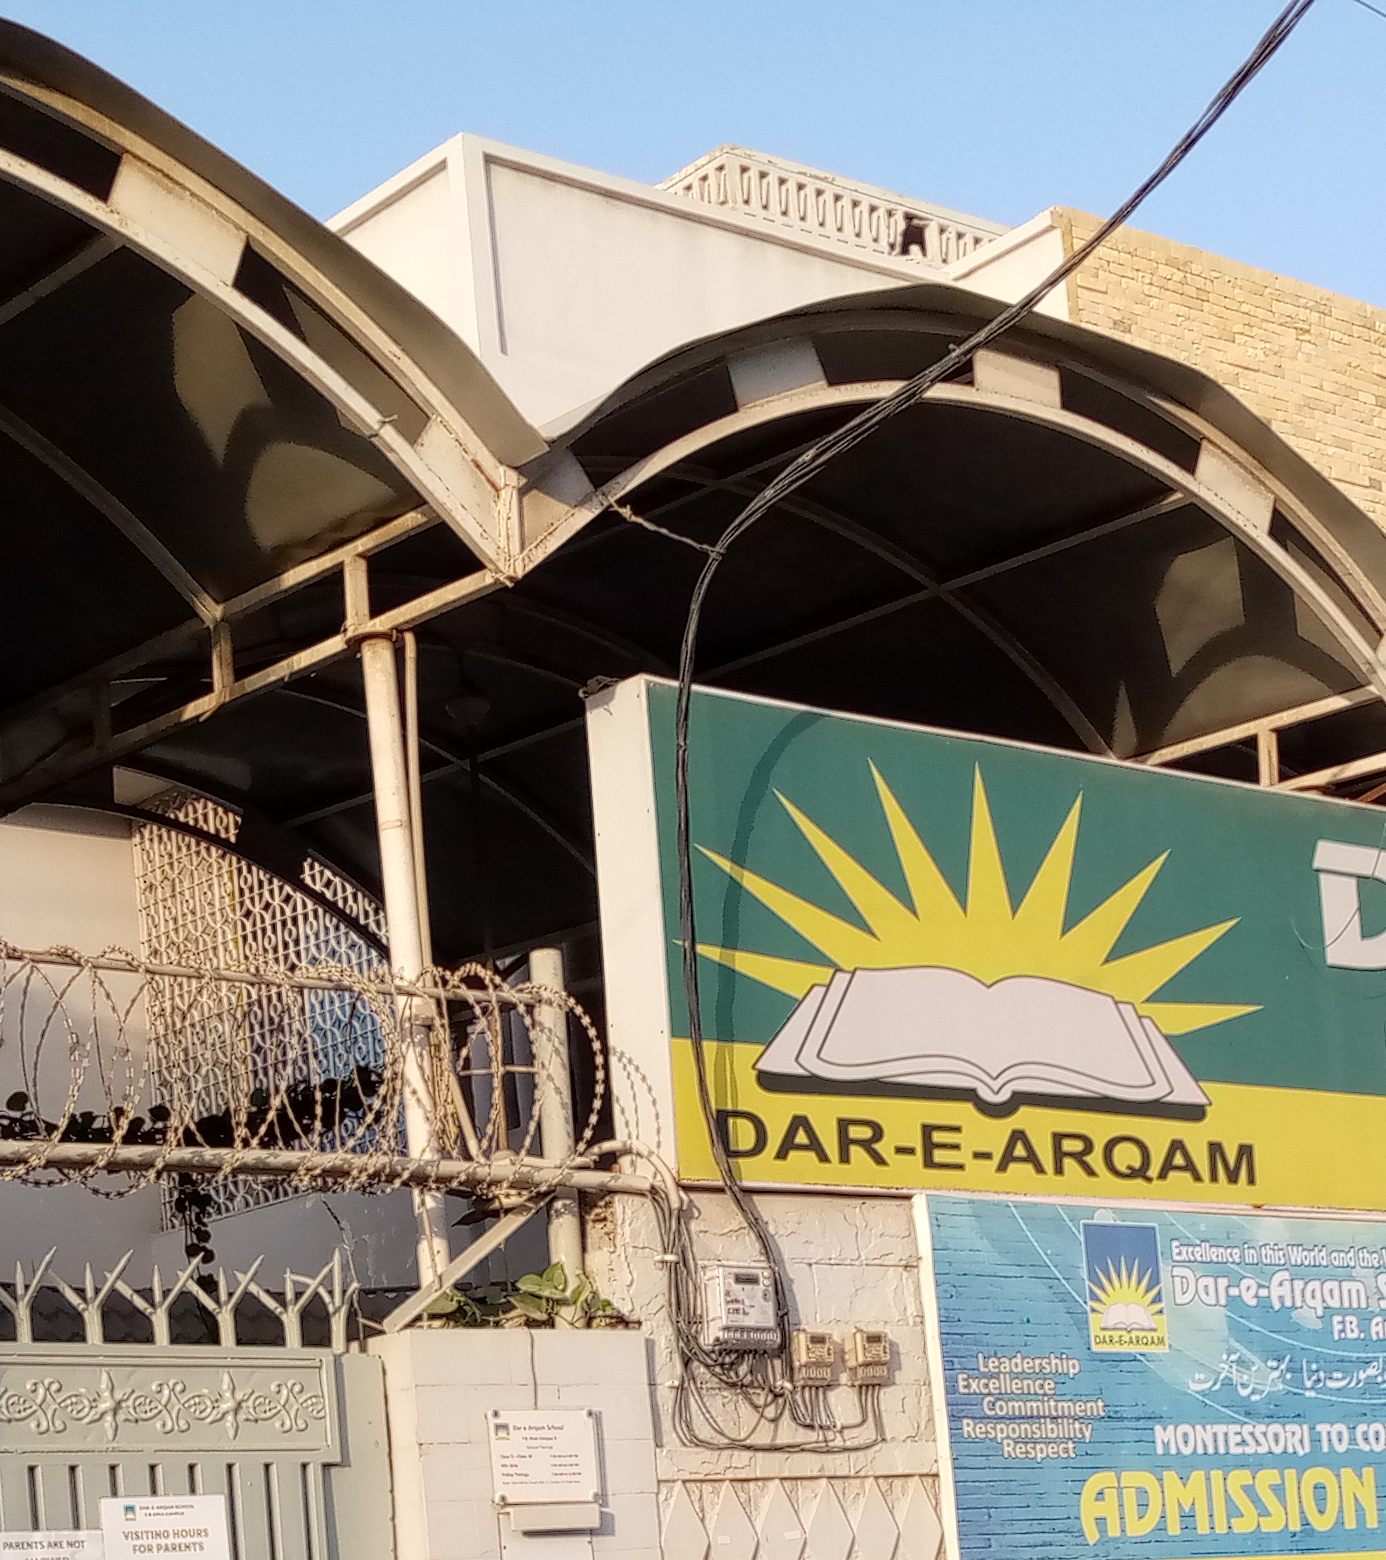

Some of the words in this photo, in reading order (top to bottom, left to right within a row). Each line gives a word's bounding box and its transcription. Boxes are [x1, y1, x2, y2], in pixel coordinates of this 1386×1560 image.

[716, 1107, 1258, 1188] DAR-E-ARQAM
[1171, 1239, 1241, 1264] Excellence
[1244, 1242, 1258, 1265] in
[1260, 1243, 1285, 1266] this
[1287, 1244, 1328, 1267] World
[1331, 1247, 1354, 1268] and
[1358, 1247, 1379, 1268] the
[1171, 1266, 1368, 1318] Dar-e-Arqam
[1331, 1313, 1365, 1341] F.B.
[1094, 1334, 1166, 1347] DAR-E-ARQAM
[976, 1352, 1081, 1379] Leadership
[1188, 1351, 1241, 1392] آخرت
[957, 1373, 1056, 1396] Excellence
[982, 1396, 1106, 1417] Commitment
[963, 1418, 1094, 1443] Responsibility
[1154, 1423, 1312, 1457] MONTESSORI
[1317, 1423, 1350, 1454] TO
[1002, 1439, 1077, 1463] Respect
[1080, 1466, 1378, 1546] ADMISSION
[3, 1541, 45, 1550] PARENTS
[47, 1540, 64, 1550] ARE
[66, 1540, 86, 1549] NOT
[122, 1529, 170, 1541] VISITING
[172, 1527, 209, 1540] HOURS
[132, 1543, 154, 1554] FOR
[156, 1541, 205, 1553] PARENTS
